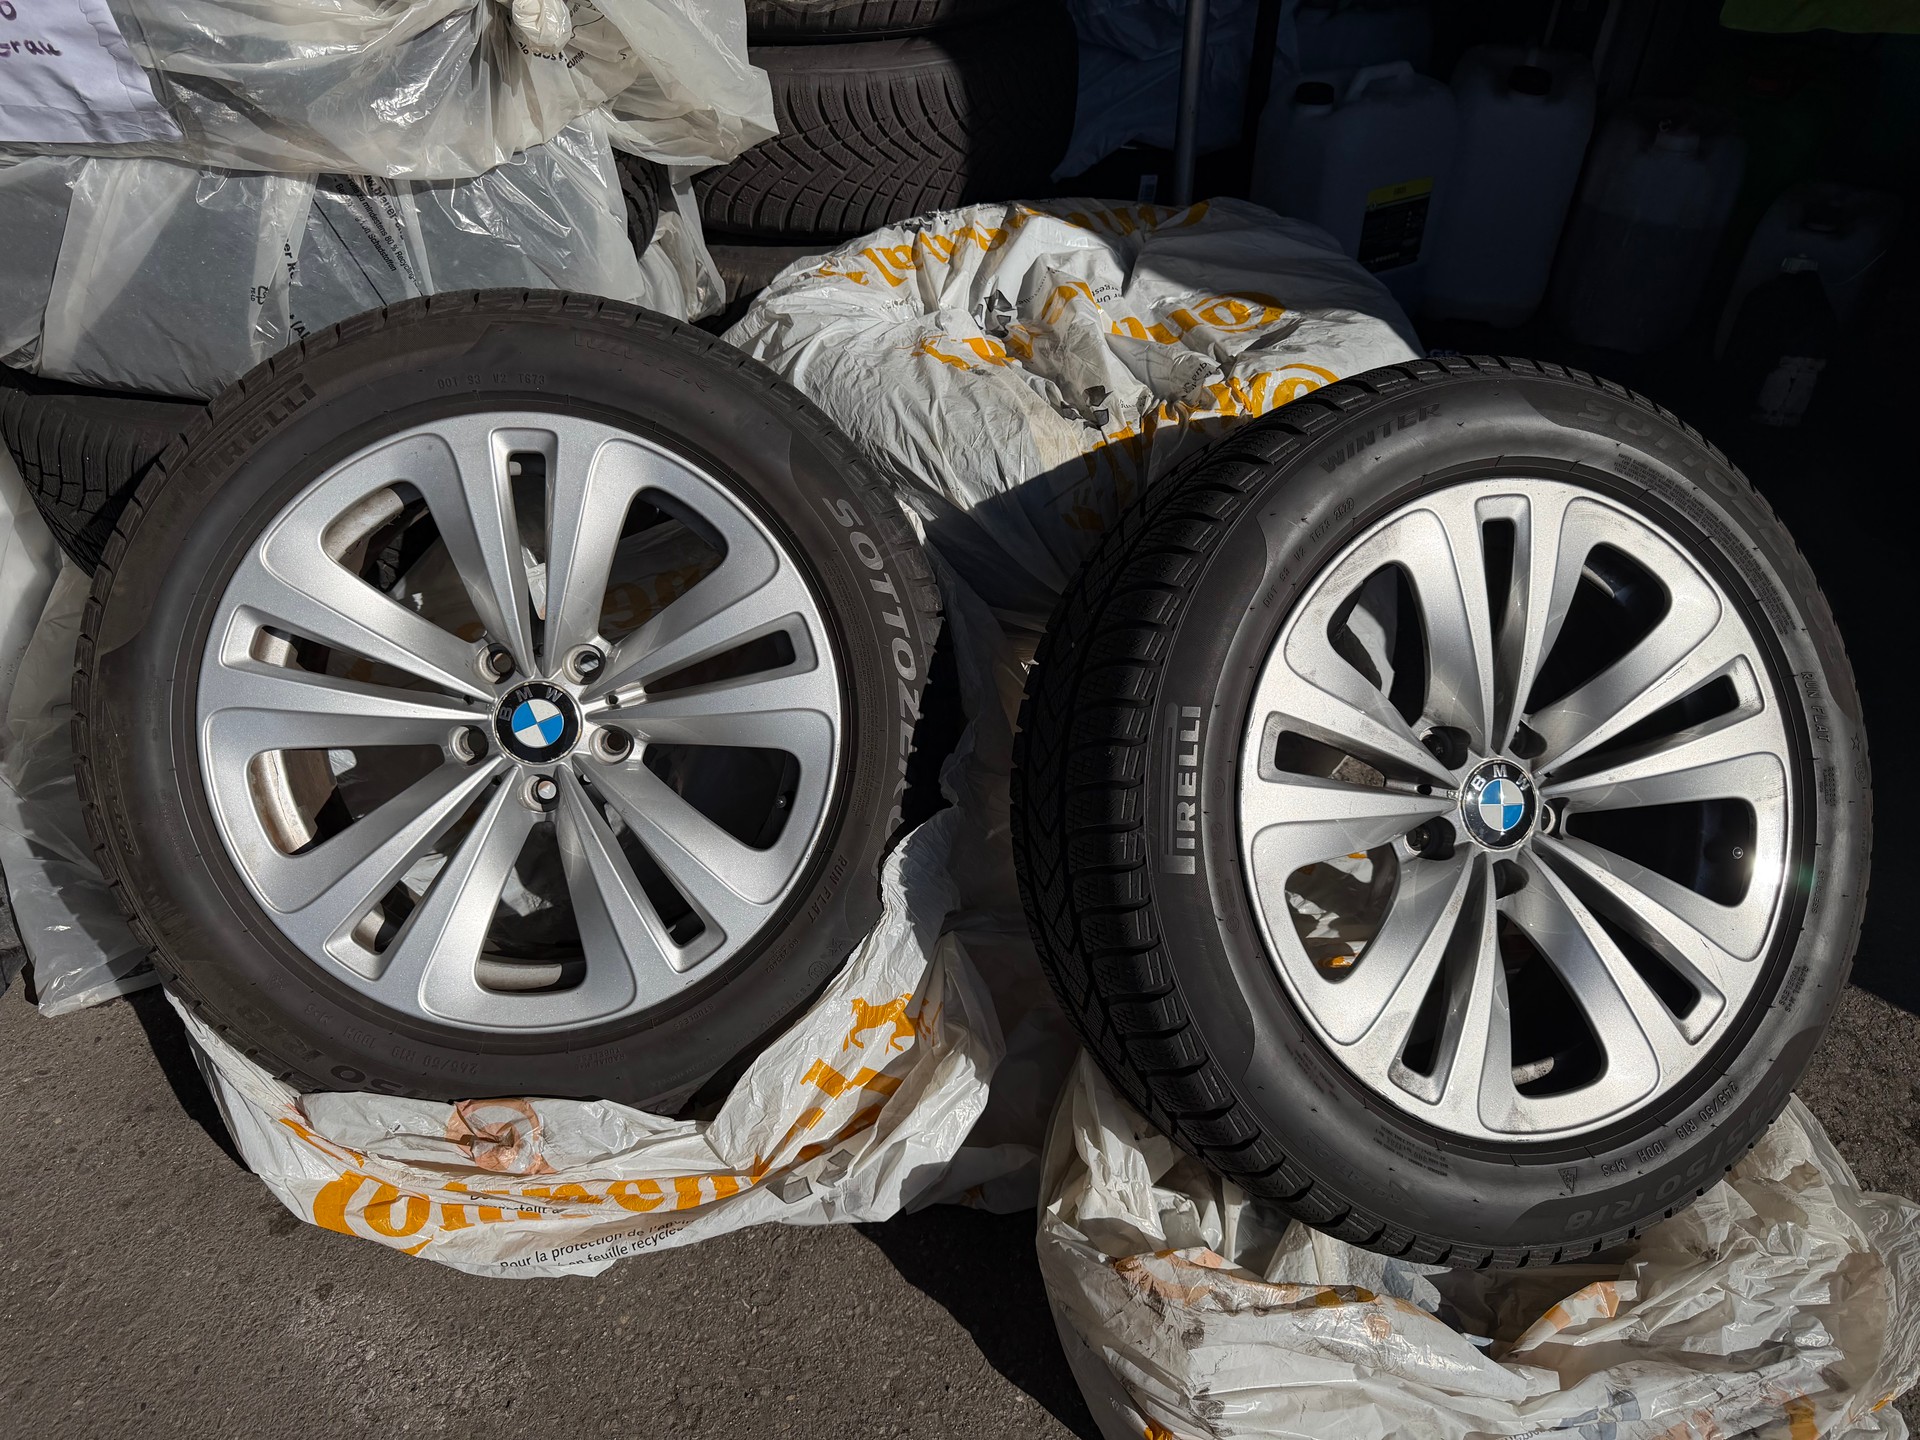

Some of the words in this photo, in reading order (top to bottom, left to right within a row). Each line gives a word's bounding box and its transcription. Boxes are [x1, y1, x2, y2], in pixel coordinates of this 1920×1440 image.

[1318, 399, 1441, 477] WINTER
[1800, 667, 1821, 700] RUN
[499, 686, 562, 721] BMW
[1810, 702, 1831, 745] FLAT
[1158, 702, 1203, 875] PIRELLI
[1471, 764, 1530, 791] BMW
[826, 853, 850, 885] RUN
[802, 884, 835, 925] FLAT
[1697, 1077, 1740, 1125] 245/50
[1674, 1116, 1698, 1142] R18
[1599, 1155, 1627, 1180] M+S
[1636, 1135, 1668, 1165] 100H
[1561, 1187, 1649, 1234] R18
[535, 1250, 548, 1263] la
[551, 1233, 623, 1261] protection
[627, 1228, 645, 1238] de
[587, 1246, 629, 1262] feuille
